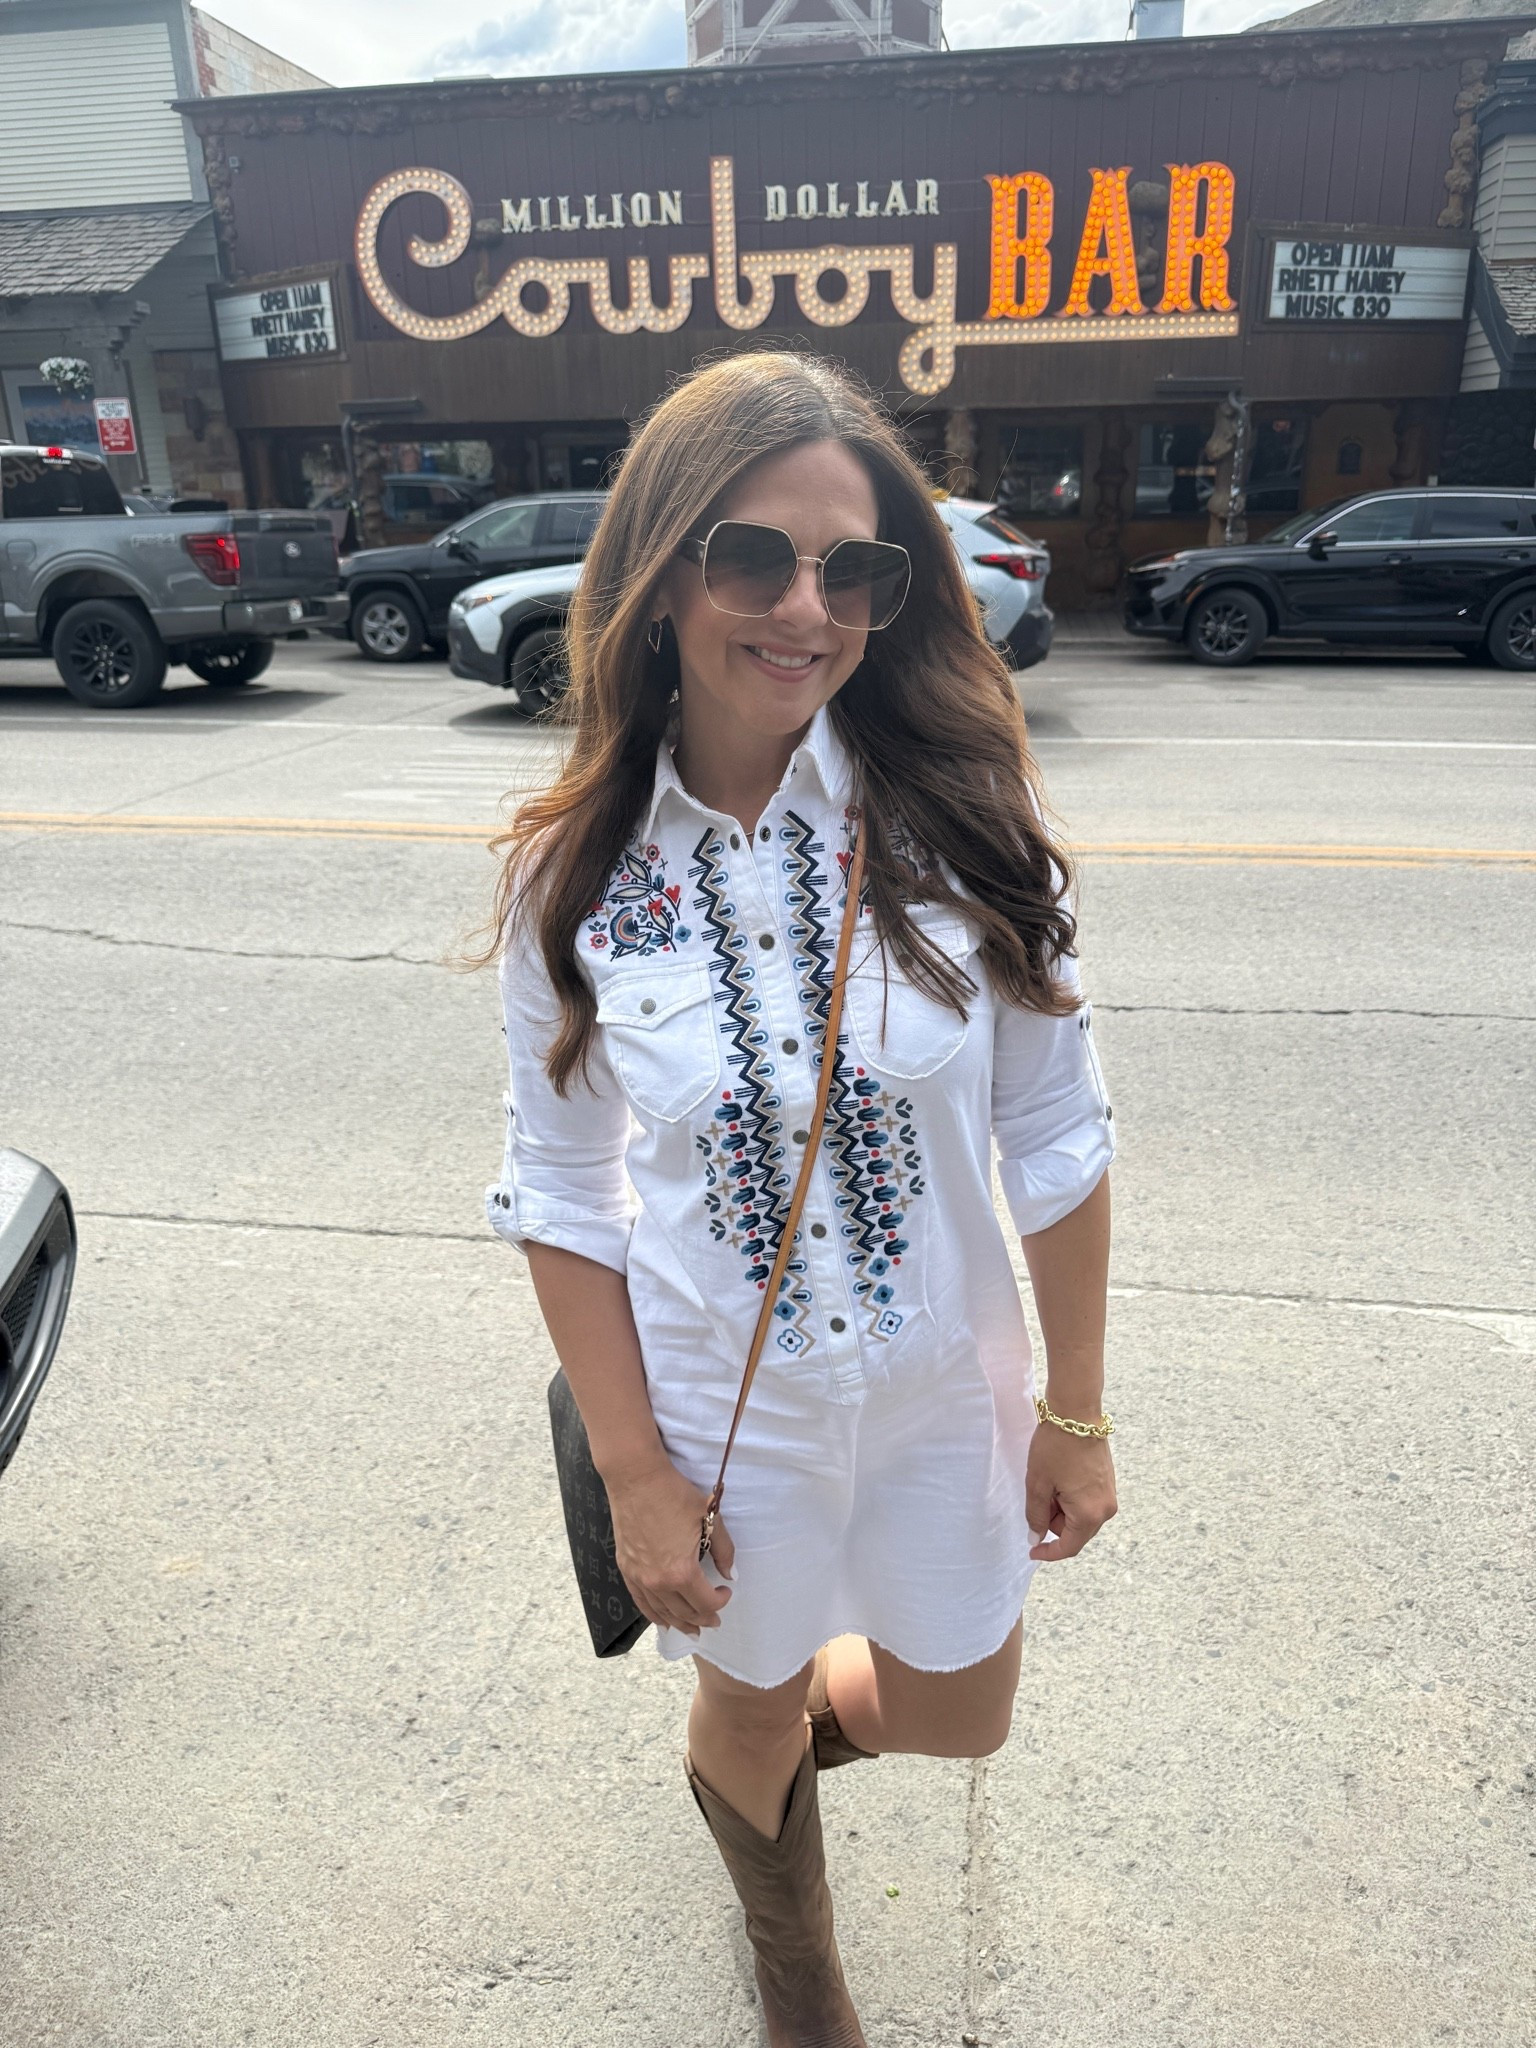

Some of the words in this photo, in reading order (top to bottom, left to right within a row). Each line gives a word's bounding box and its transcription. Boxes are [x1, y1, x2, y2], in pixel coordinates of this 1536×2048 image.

[501, 189, 684, 234] MILLION
[765, 178, 939, 222] DOLLAR
[1291, 242, 1344, 267] OPEN
[1350, 244, 1396, 269] 11AM
[353, 156, 959, 396] Cowboy
[982, 161, 1238, 319] BAR
[1278, 268, 1339, 293] RHETT
[260, 288, 290, 313] OPEN
[1285, 294, 1346, 318] MUSIC
[1352, 295, 1391, 318] 830
